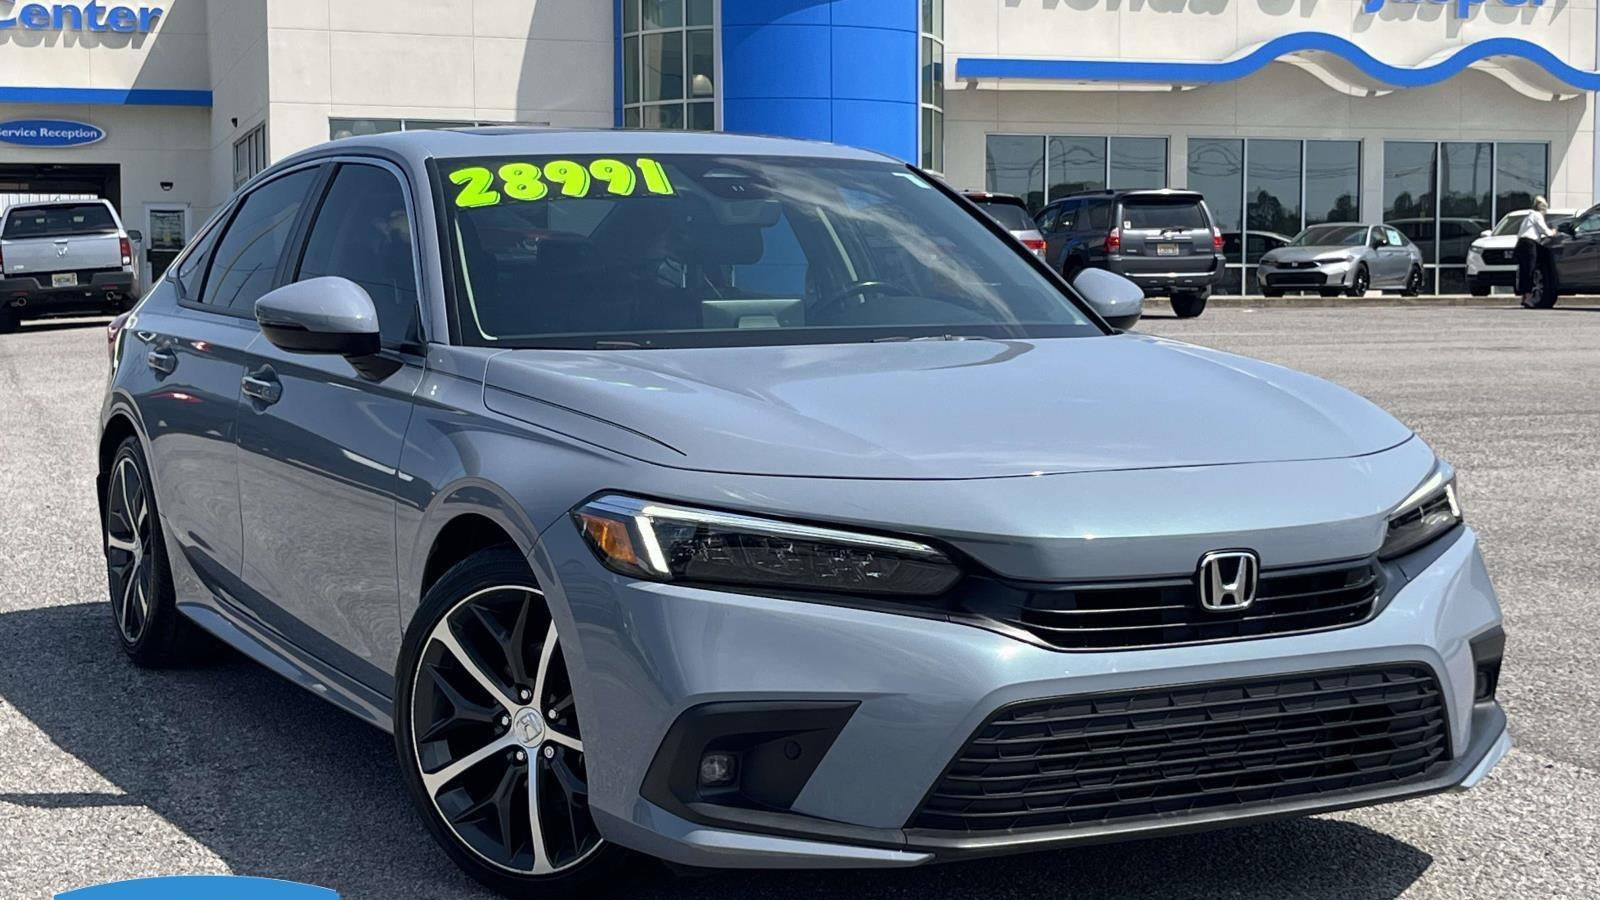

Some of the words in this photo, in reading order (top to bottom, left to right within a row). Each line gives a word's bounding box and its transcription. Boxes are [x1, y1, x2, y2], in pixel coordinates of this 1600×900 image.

[0, 128, 37, 137] ervice
[40, 128, 97, 140] Reception
[449, 158, 674, 208] 28991
